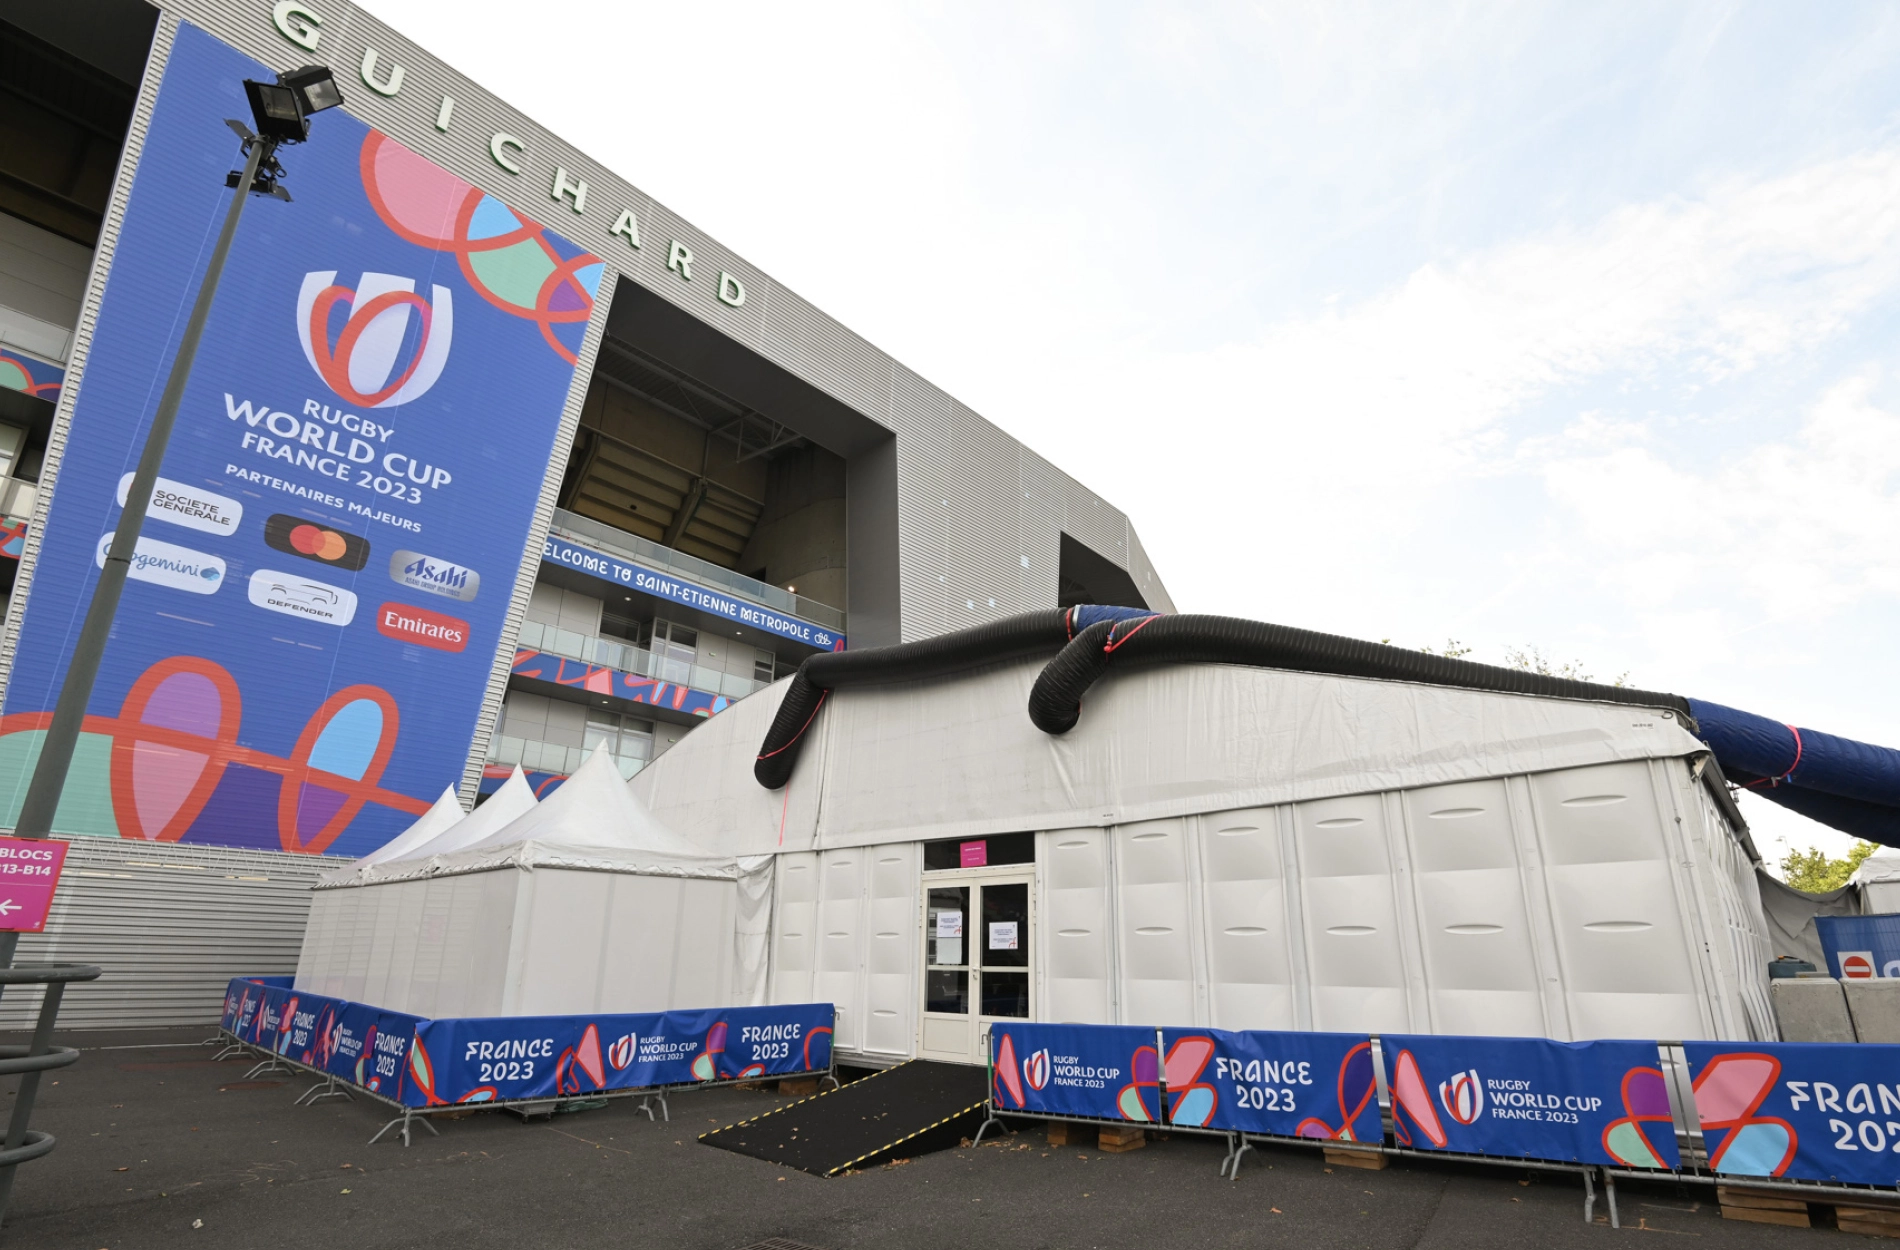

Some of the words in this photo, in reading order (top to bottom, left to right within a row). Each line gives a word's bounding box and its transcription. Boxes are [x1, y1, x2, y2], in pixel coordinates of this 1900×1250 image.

[272, 0, 748, 308] GUICHARD
[303, 398, 395, 443] RUGBY
[224, 392, 375, 463] WORLD
[383, 453, 452, 489] CUP
[241, 431, 351, 481] FRANCE
[356, 470, 422, 504] 2023
[155, 490, 220, 514] SOCIETE
[225, 463, 344, 508] PARTENAIRES
[348, 502, 422, 532] MAJEURS
[153, 498, 231, 526] GENERALE
[404, 557, 468, 589] Asahi
[543, 542, 608, 575] ELCOME
[612, 564, 632, 582] TO
[636, 573, 737, 616] SAINT-ETIENNE
[740, 606, 810, 640] METROPOLE
[267, 598, 334, 619] DEFENDER
[384, 610, 463, 643] Emirates
[0, 848, 53, 861] BLOCS
[0, 863, 52, 876] 13-B14
[375, 1032, 405, 1056] FRANCE
[640, 1036, 665, 1044] RUGBY
[741, 1023, 801, 1043] FRANCE
[465, 1038, 554, 1061] FRANCE
[638, 1054, 666, 1063] FRANCE
[667, 1052, 685, 1060] 2023
[640, 1043, 677, 1054] WORLD
[678, 1042, 698, 1052] CUP
[751, 1042, 789, 1061] 2023
[1053, 1055, 1079, 1064] RUGBY
[376, 1054, 396, 1077] 2023
[479, 1061, 534, 1082] 2023
[1053, 1065, 1095, 1078] WORLD
[1097, 1067, 1120, 1079] CUP
[1216, 1056, 1313, 1085] FRANCE
[1054, 1077, 1083, 1087] FRANCE
[1084, 1079, 1105, 1089] 2023
[1487, 1079, 1531, 1091] RUGBY
[1236, 1083, 1296, 1112] 2023
[1489, 1091, 1561, 1109] WORLD
[1564, 1095, 1602, 1112] CUP
[1786, 1081, 1900, 1115] FRAN
[1492, 1107, 1543, 1121] FRANCE
[1545, 1110, 1579, 1124] 2023
